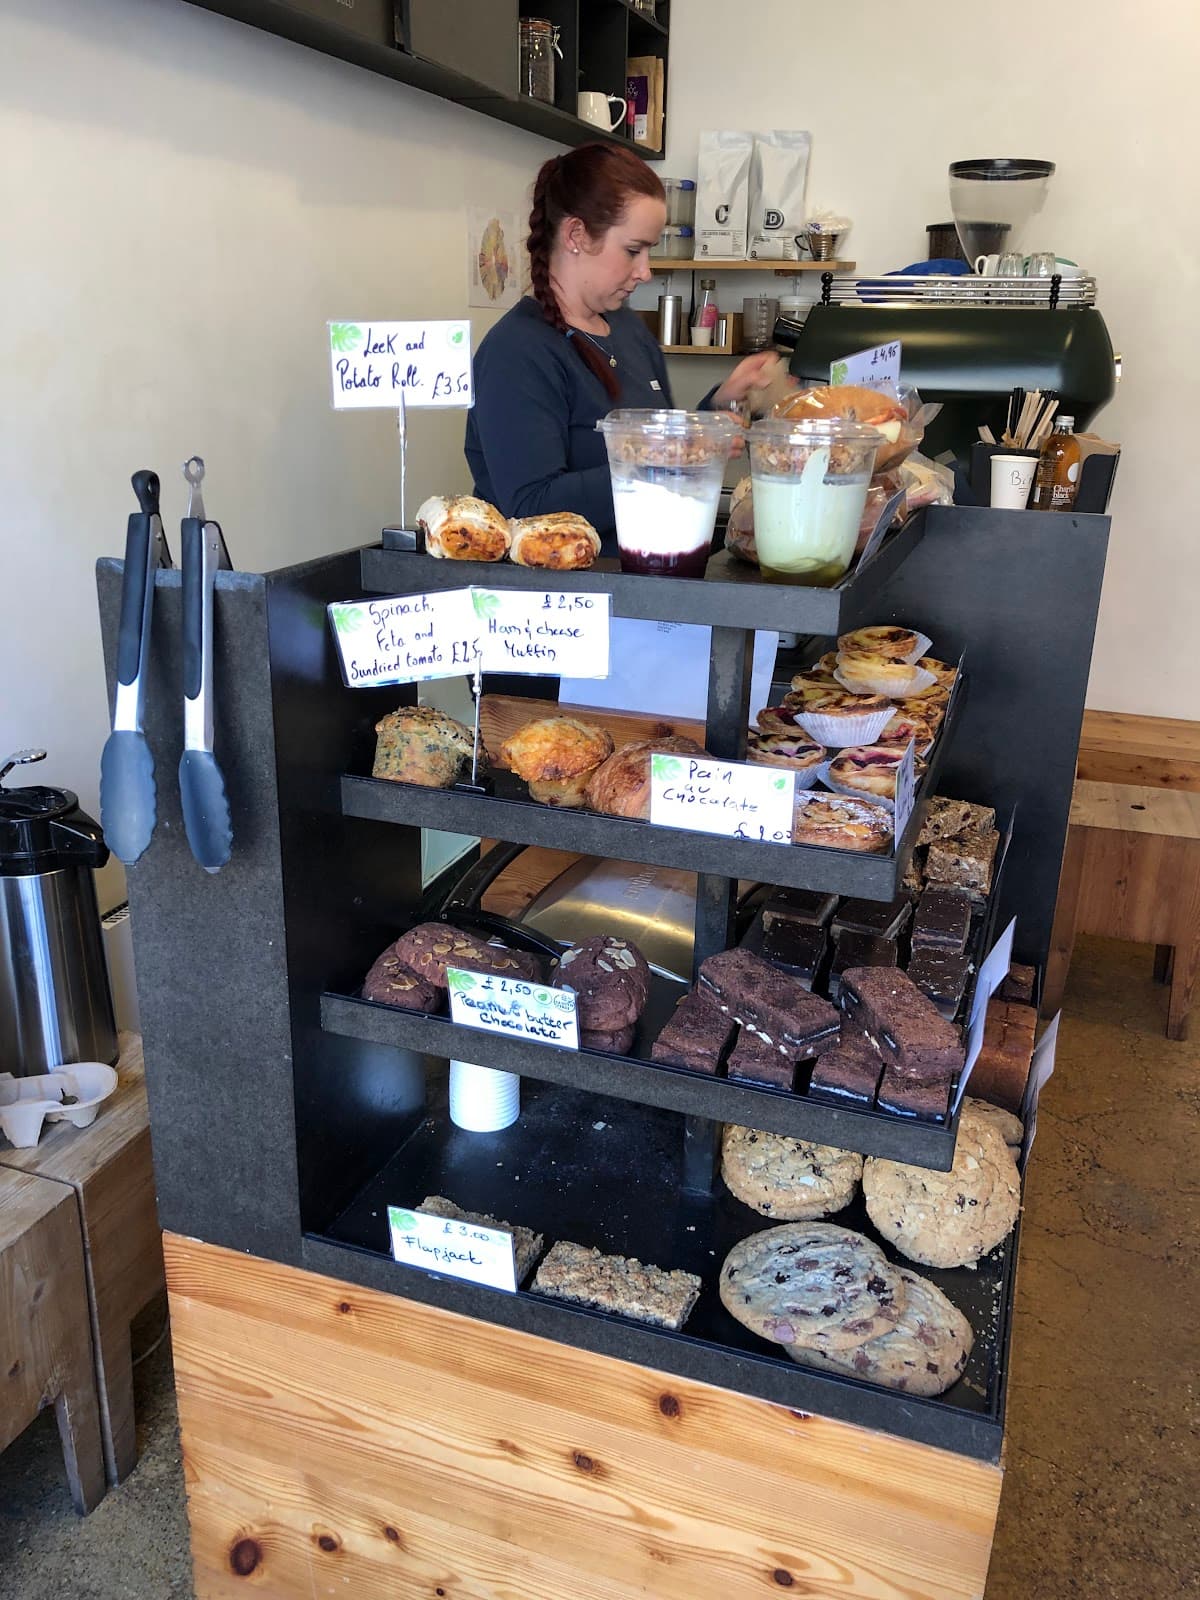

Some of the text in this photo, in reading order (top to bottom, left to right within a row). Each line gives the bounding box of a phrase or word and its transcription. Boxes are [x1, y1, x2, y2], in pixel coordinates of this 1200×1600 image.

[715, 204, 729, 225] C
[763, 208, 785, 231] D
[405, 330, 426, 351] and
[336, 358, 382, 392] Potato
[376, 621, 434, 653] Feta and
[488, 616, 522, 636] Ham
[536, 620, 585, 639] cheese
[350, 654, 401, 681] Sundried
[406, 643, 443, 668] tomato
[689, 760, 733, 785] Pain
[525, 1008, 574, 1031] butter
[401, 1234, 483, 1265] Flapjack
